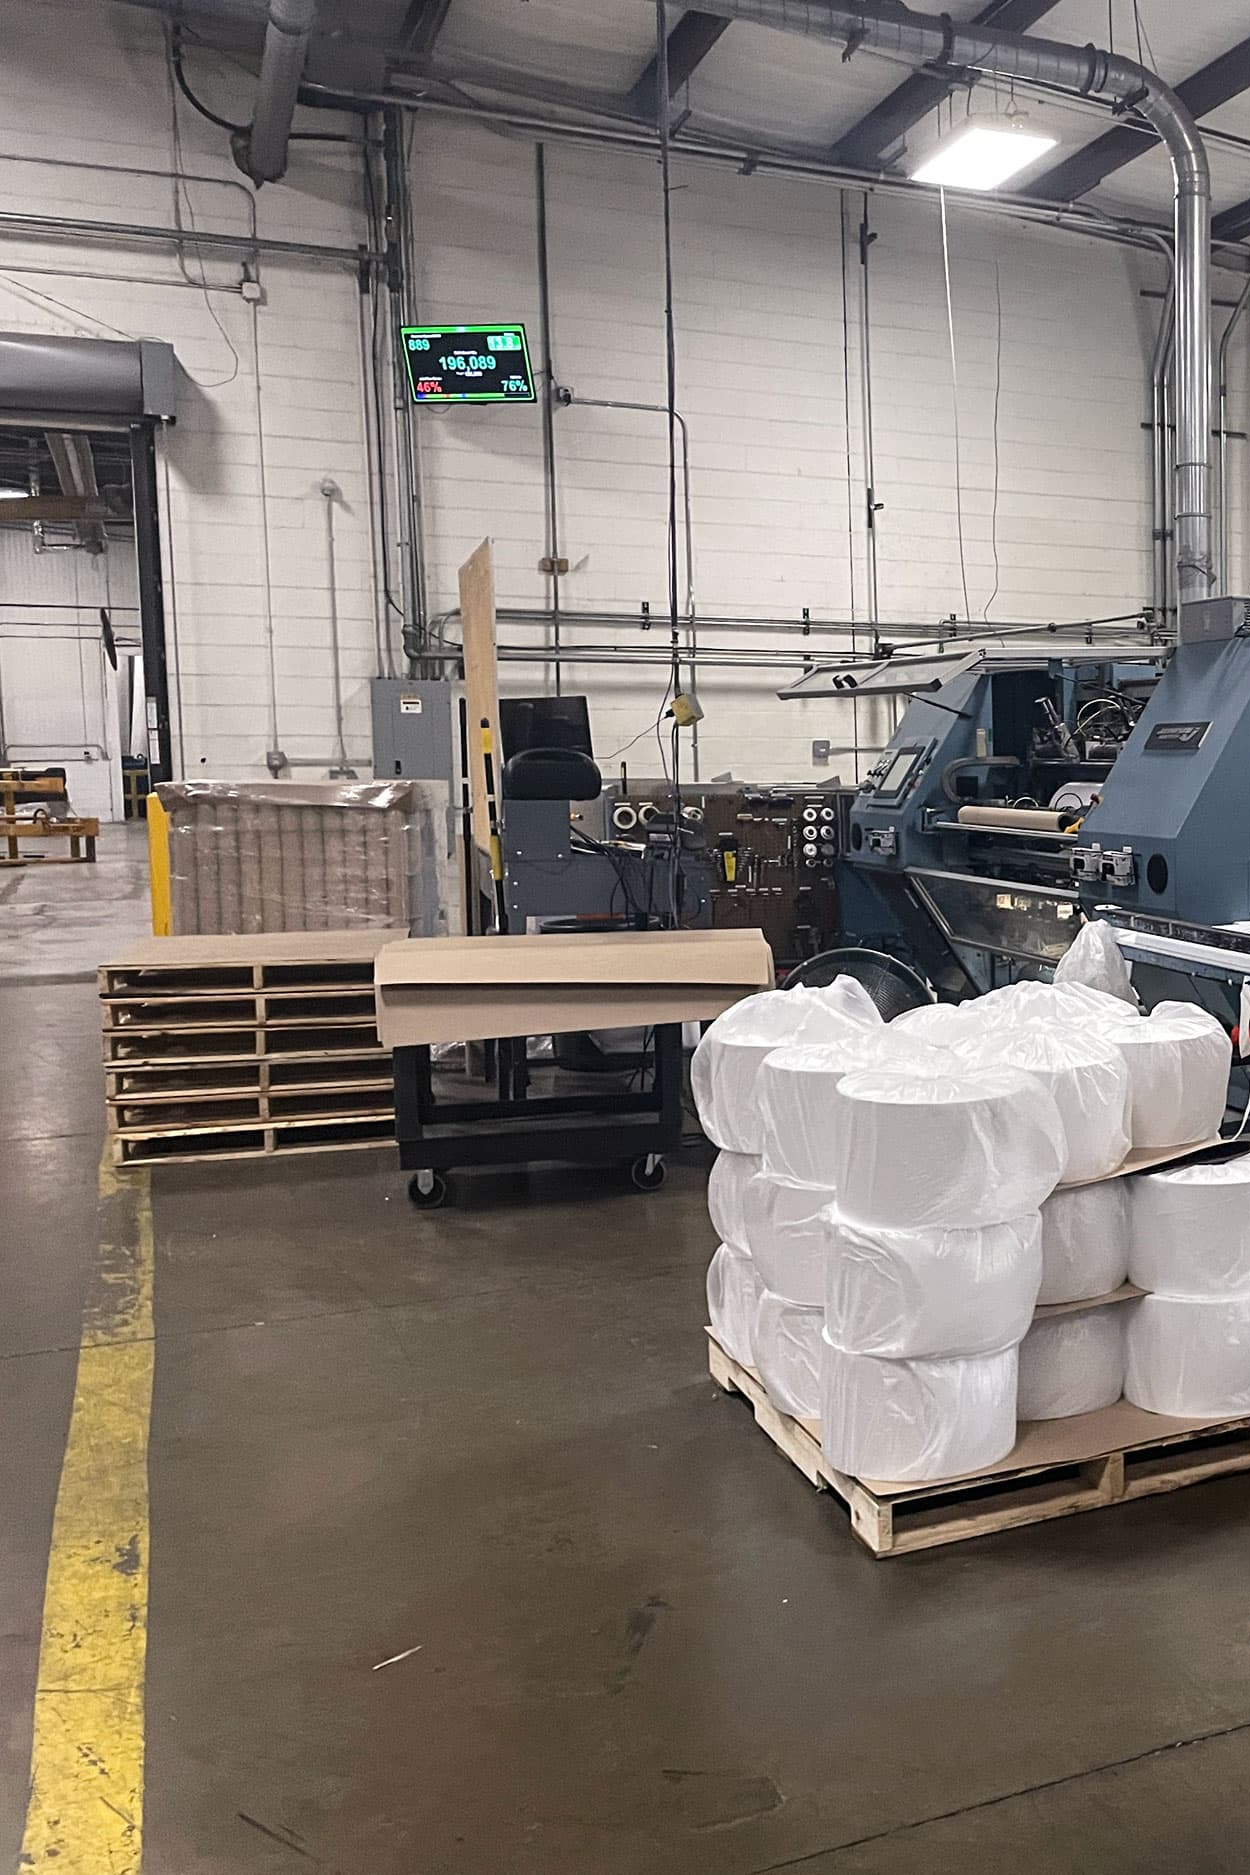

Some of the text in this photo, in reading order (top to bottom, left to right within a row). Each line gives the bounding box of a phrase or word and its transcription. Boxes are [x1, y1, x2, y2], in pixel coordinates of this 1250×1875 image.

[408, 339, 430, 351] 889
[439, 356, 496, 371] 196,089
[417, 382, 442, 393] 46%
[501, 380, 528, 392] 76%
